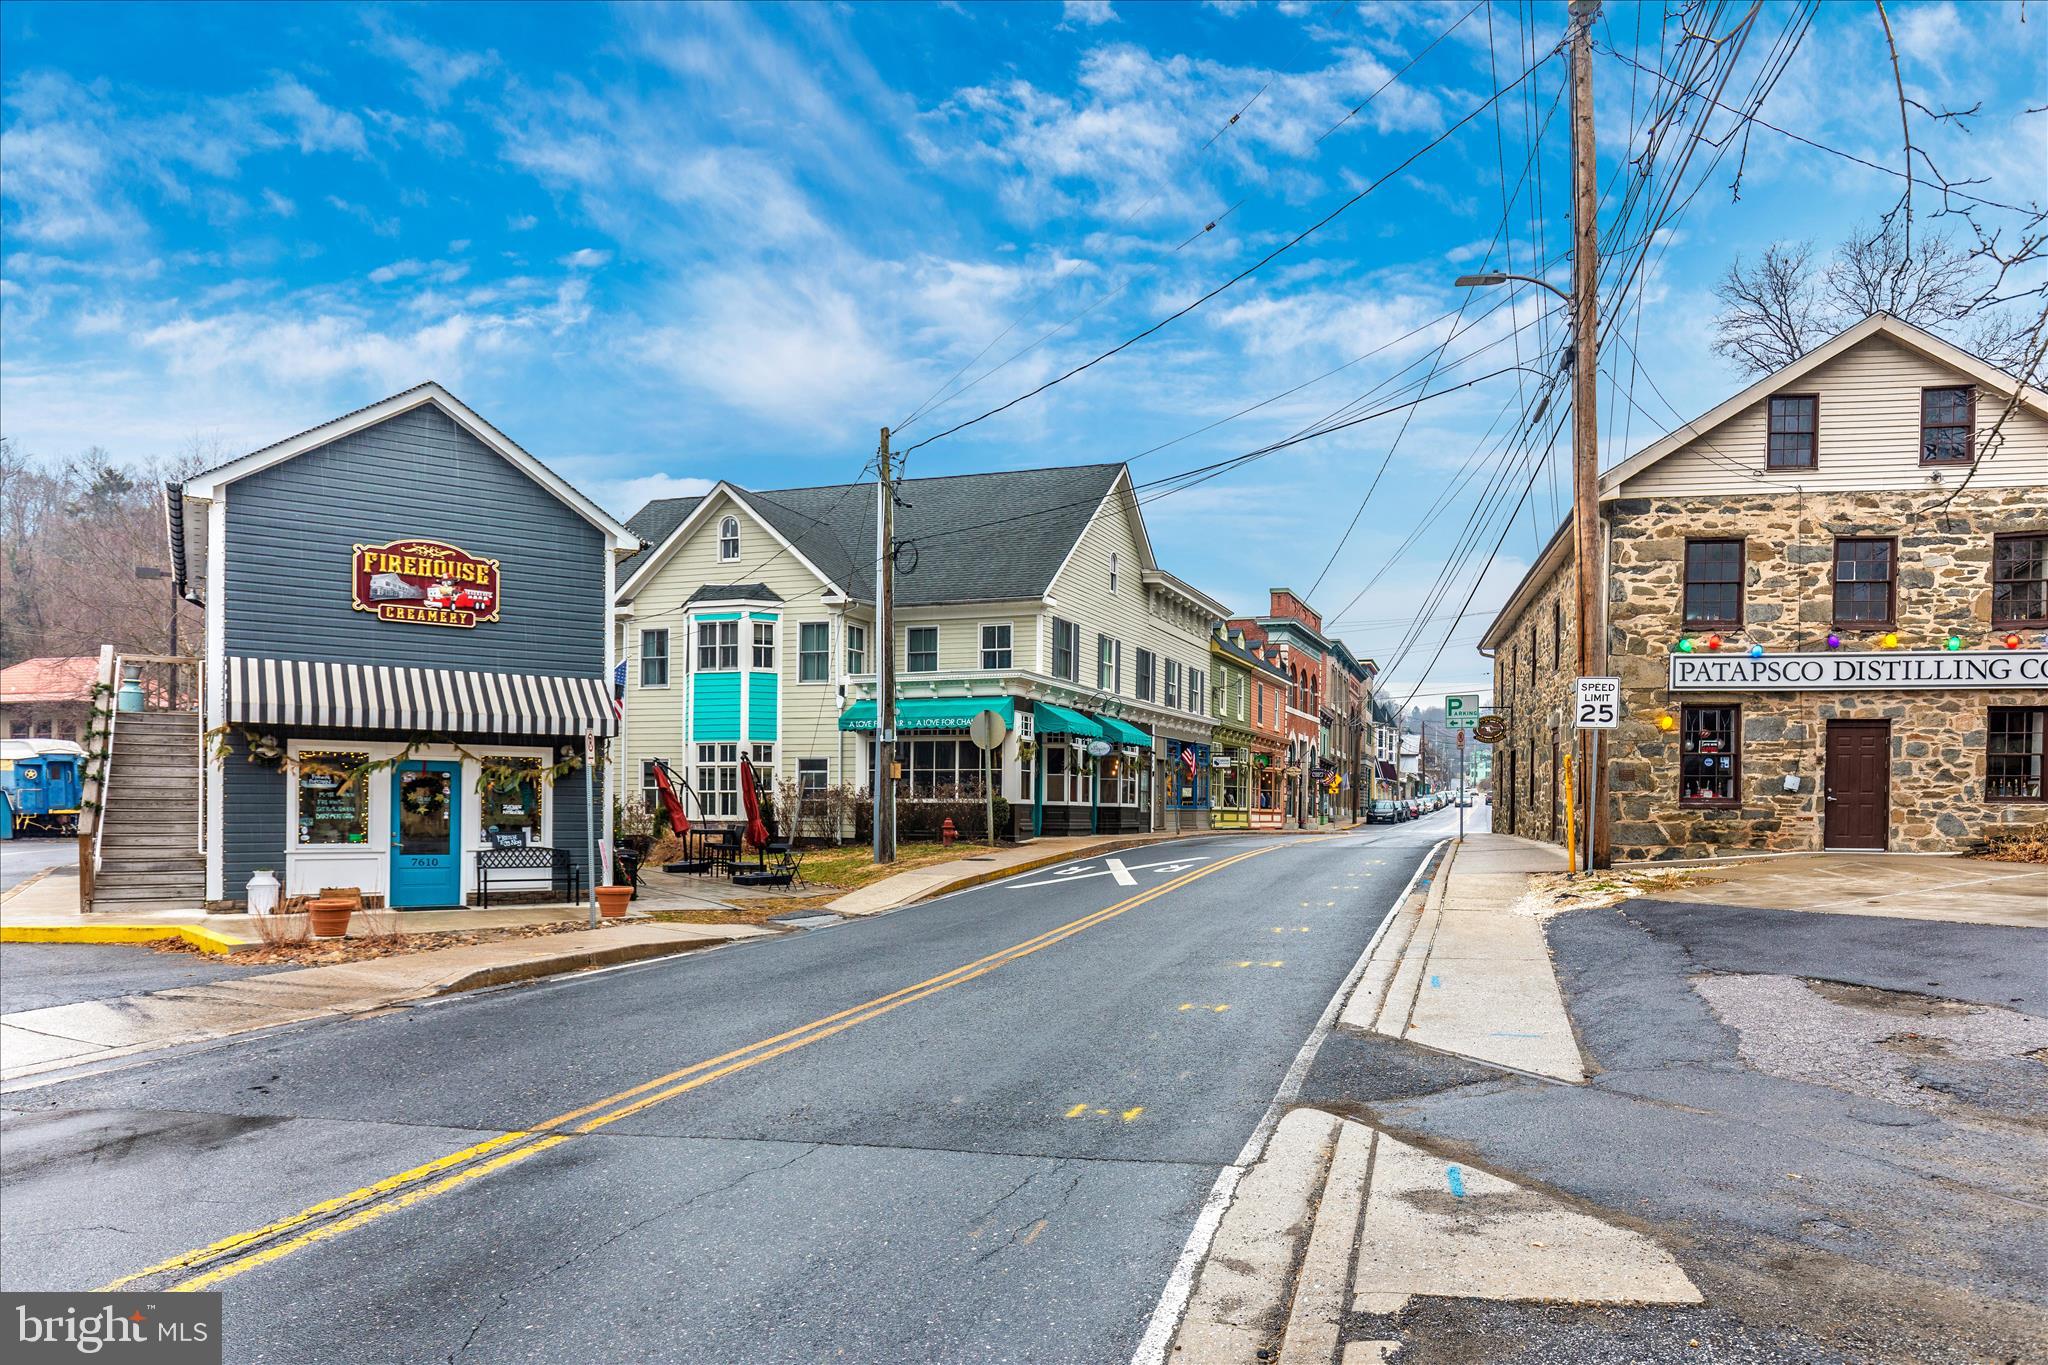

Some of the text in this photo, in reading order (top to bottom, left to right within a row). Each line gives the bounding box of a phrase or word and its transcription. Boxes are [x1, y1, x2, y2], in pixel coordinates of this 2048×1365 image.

[363, 551, 490, 585] FIREHOUSE
[386, 606, 468, 625] CREAMERY
[1679, 661, 1824, 683] PATAPSCO
[1833, 658, 2012, 681] DISTILLING
[1581, 683, 1616, 692] SPEED
[1584, 693, 1611, 702] LIMIT
[1580, 704, 1614, 723] 25
[855, 720, 872, 728] LOVE
[923, 718, 940, 726] LOVE
[941, 718, 955, 726] FOR
[956, 718, 974, 726] CHA
[411, 857, 439, 867] 7610
